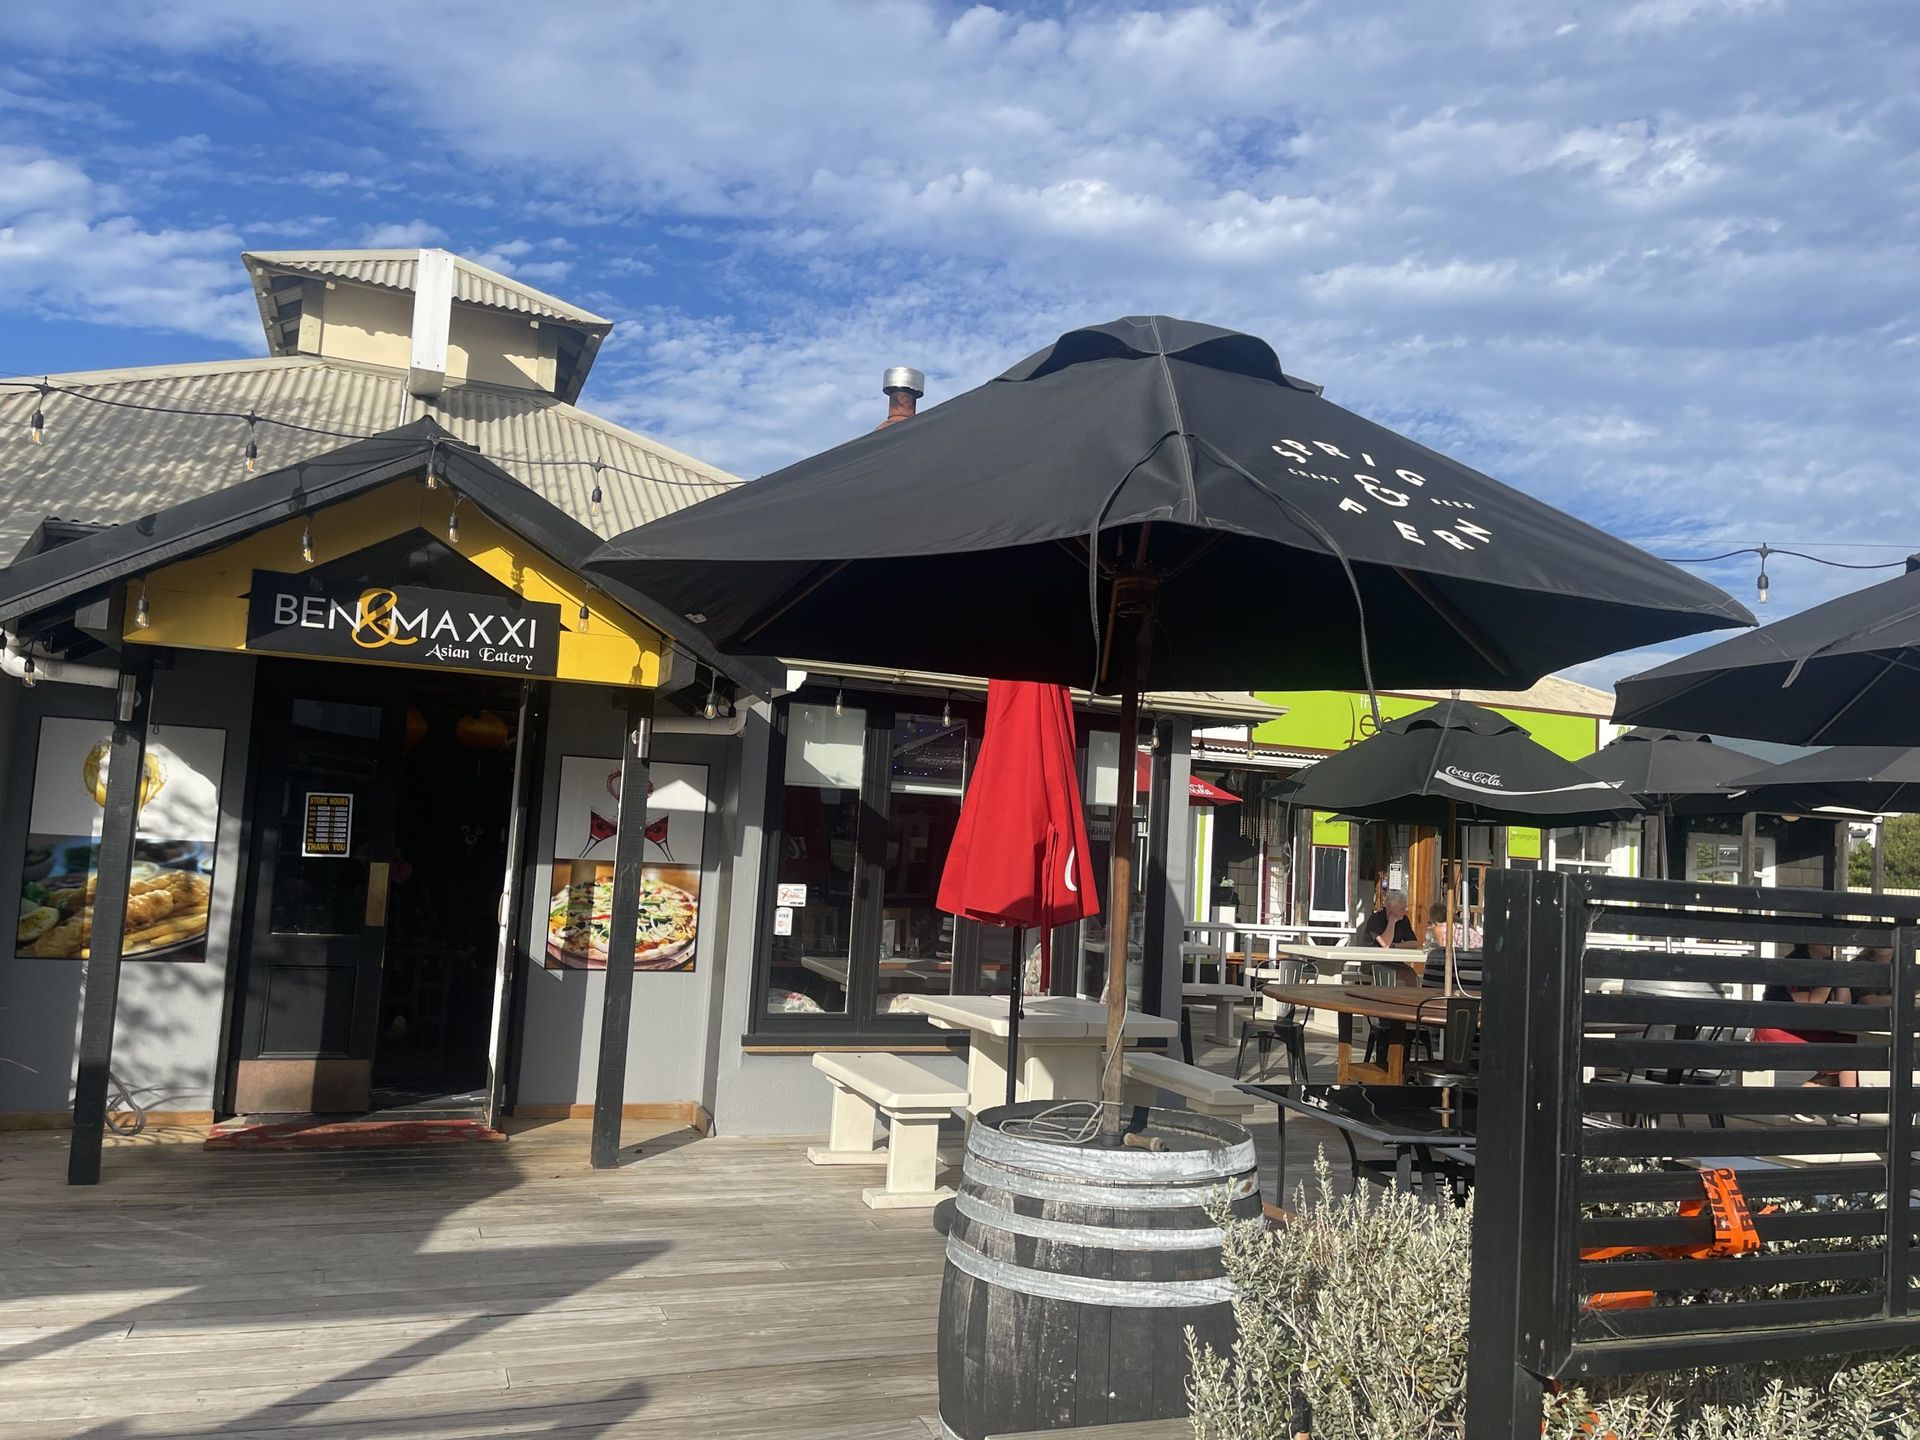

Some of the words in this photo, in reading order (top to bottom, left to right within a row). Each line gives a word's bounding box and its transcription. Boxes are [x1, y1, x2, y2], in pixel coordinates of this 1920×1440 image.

[1272, 439, 1427, 486] SPRIG
[1338, 497, 1492, 550] FERN
[274, 593, 362, 633] BEN
[351, 587, 418, 649] &
[388, 603, 537, 649] MAXXI
[425, 643, 470, 660] Asian
[478, 646, 534, 671] Eatery
[307, 842, 330, 851] THANK
[332, 843, 346, 851] YOU
